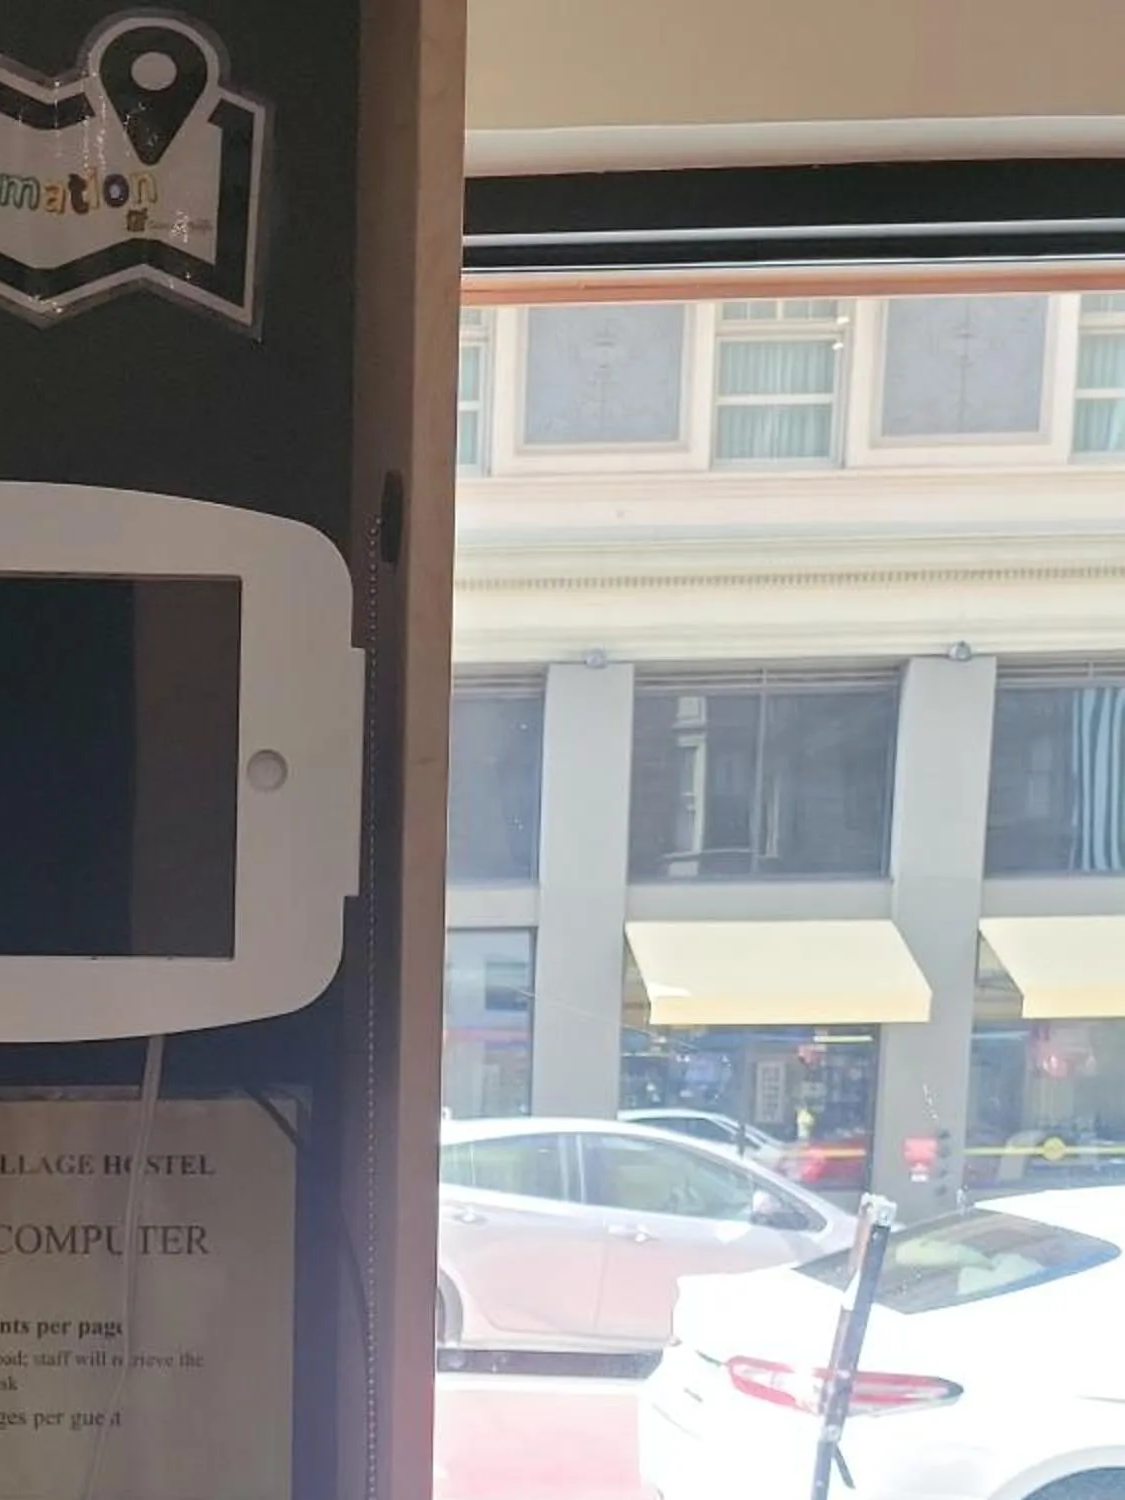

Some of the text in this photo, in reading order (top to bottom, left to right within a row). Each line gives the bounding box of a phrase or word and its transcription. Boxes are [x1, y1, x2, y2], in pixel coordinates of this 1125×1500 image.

[36, 1319, 72, 1339] per
[33, 1350, 73, 1367] staff
[75, 1351, 106, 1367] will
[111, 1355, 174, 1368] rerieve
[179, 1352, 205, 1368] the
[33, 1412, 65, 1430] per
